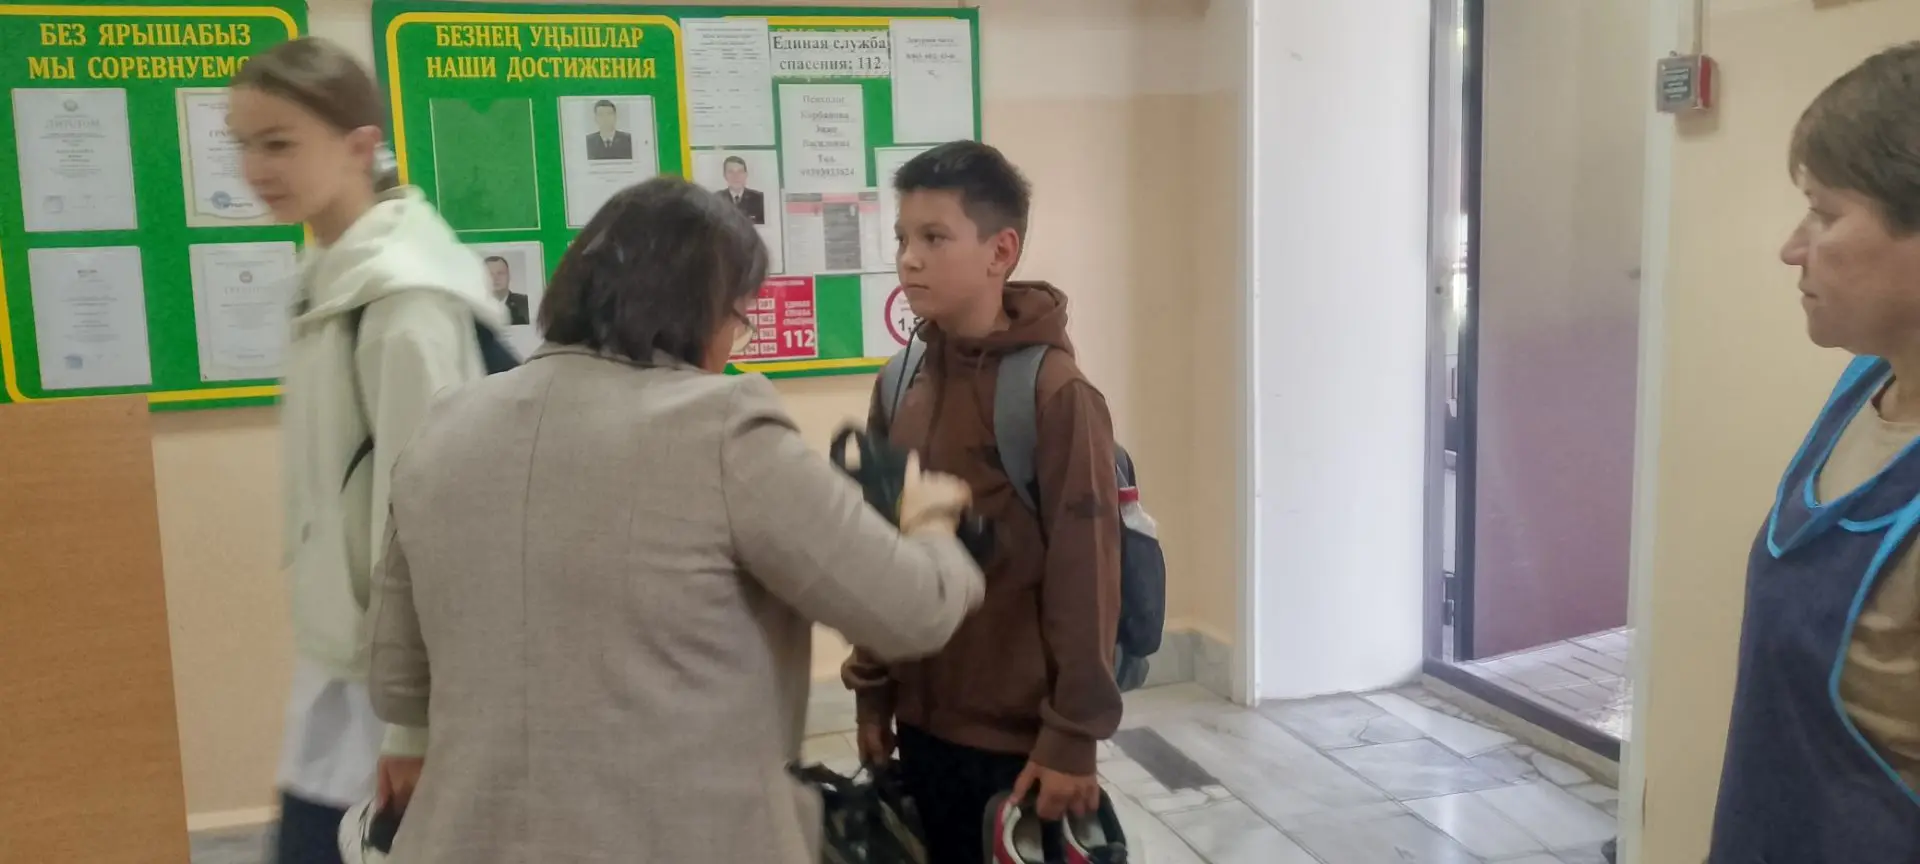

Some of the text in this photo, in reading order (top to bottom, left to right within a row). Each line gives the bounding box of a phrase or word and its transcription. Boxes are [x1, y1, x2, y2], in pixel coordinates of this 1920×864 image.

[40, 23, 251, 47] БЕЗ ЯРЫШАБЫЗ
[436, 25, 644, 52] БЕЗНЕҢ УҢЫШЛАР
[773, 36, 829, 50] Единая
[833, 36, 887, 52] служба
[27, 56, 76, 80] МЫ
[426, 56, 656, 82] НАШИ ДОСТИЖЕНИЯ
[780, 56, 881, 70] спасения: 112
[782, 328, 815, 348] 112
